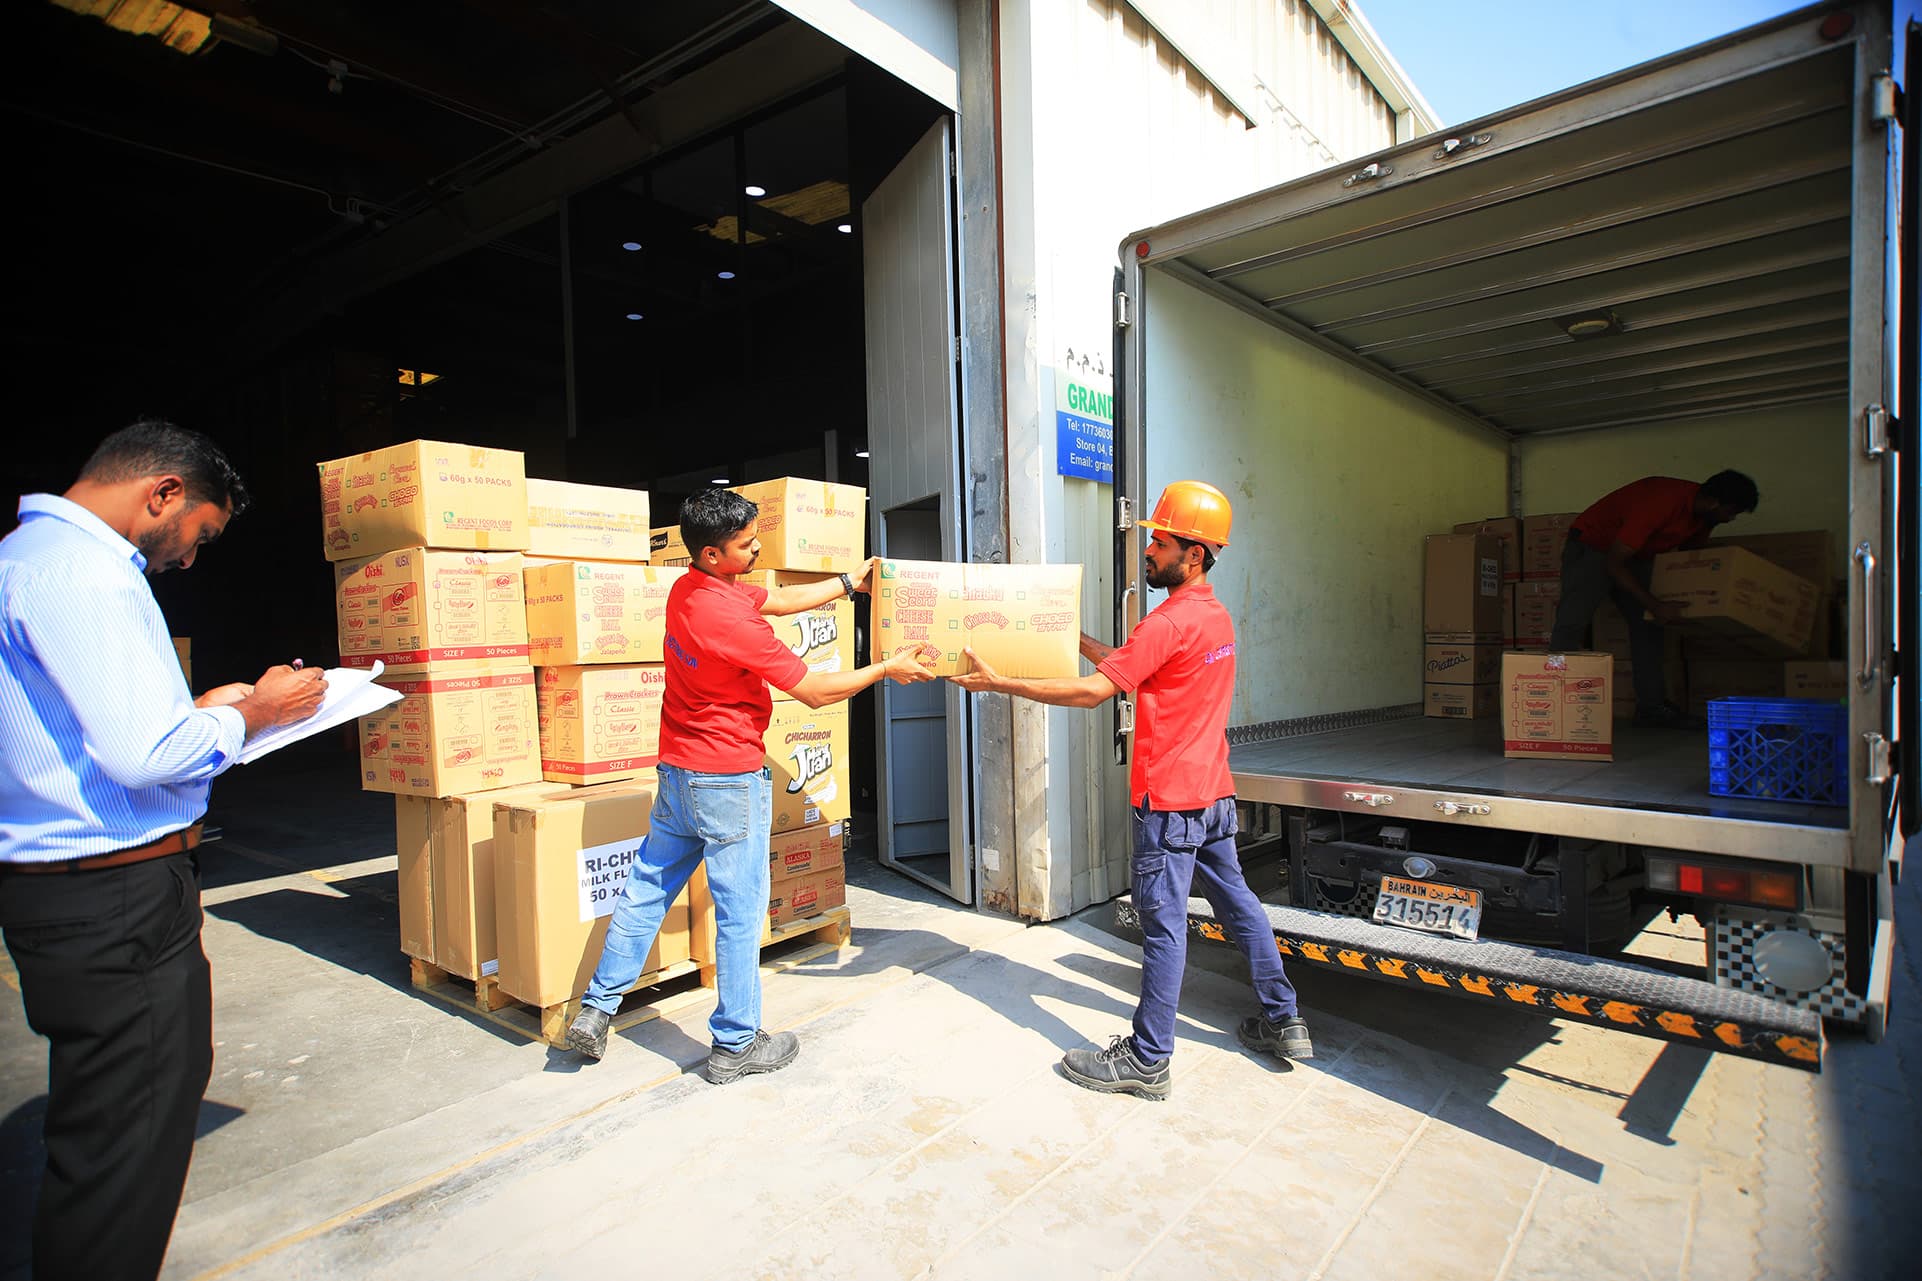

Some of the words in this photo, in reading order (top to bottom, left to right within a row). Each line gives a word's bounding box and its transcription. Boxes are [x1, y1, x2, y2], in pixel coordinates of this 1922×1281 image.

[1067, 418, 1080, 432] Tel:
[1076, 438, 1096, 452] Store
[1070, 453, 1093, 468] Email:
[450, 474, 465, 484] 60g
[475, 476, 484, 485] 50
[486, 477, 512, 487] PACKS
[900, 570, 940, 580] REGENT
[896, 609, 934, 624] CHEESE
[1030, 612, 1074, 625] CHOCO
[496, 647, 517, 655] Pieces
[395, 655, 412, 663] Pieces
[1427, 654, 1471, 673] Piattos
[447, 680, 471, 688] Pieces
[471, 679, 481, 687] 50
[509, 676, 523, 684] SIZE
[785, 730, 832, 744] CHICHARRON
[609, 761, 625, 770] SIZE
[627, 760, 633, 768] F
[786, 852, 811, 864] ALASKA
[581, 873, 611, 889] MILK
[590, 888, 607, 902] 50
[611, 887, 620, 897] x
[1388, 881, 1427, 896] BAHRAIN
[1429, 887, 1471, 903] البحرين
[1376, 894, 1470, 934] 315514
